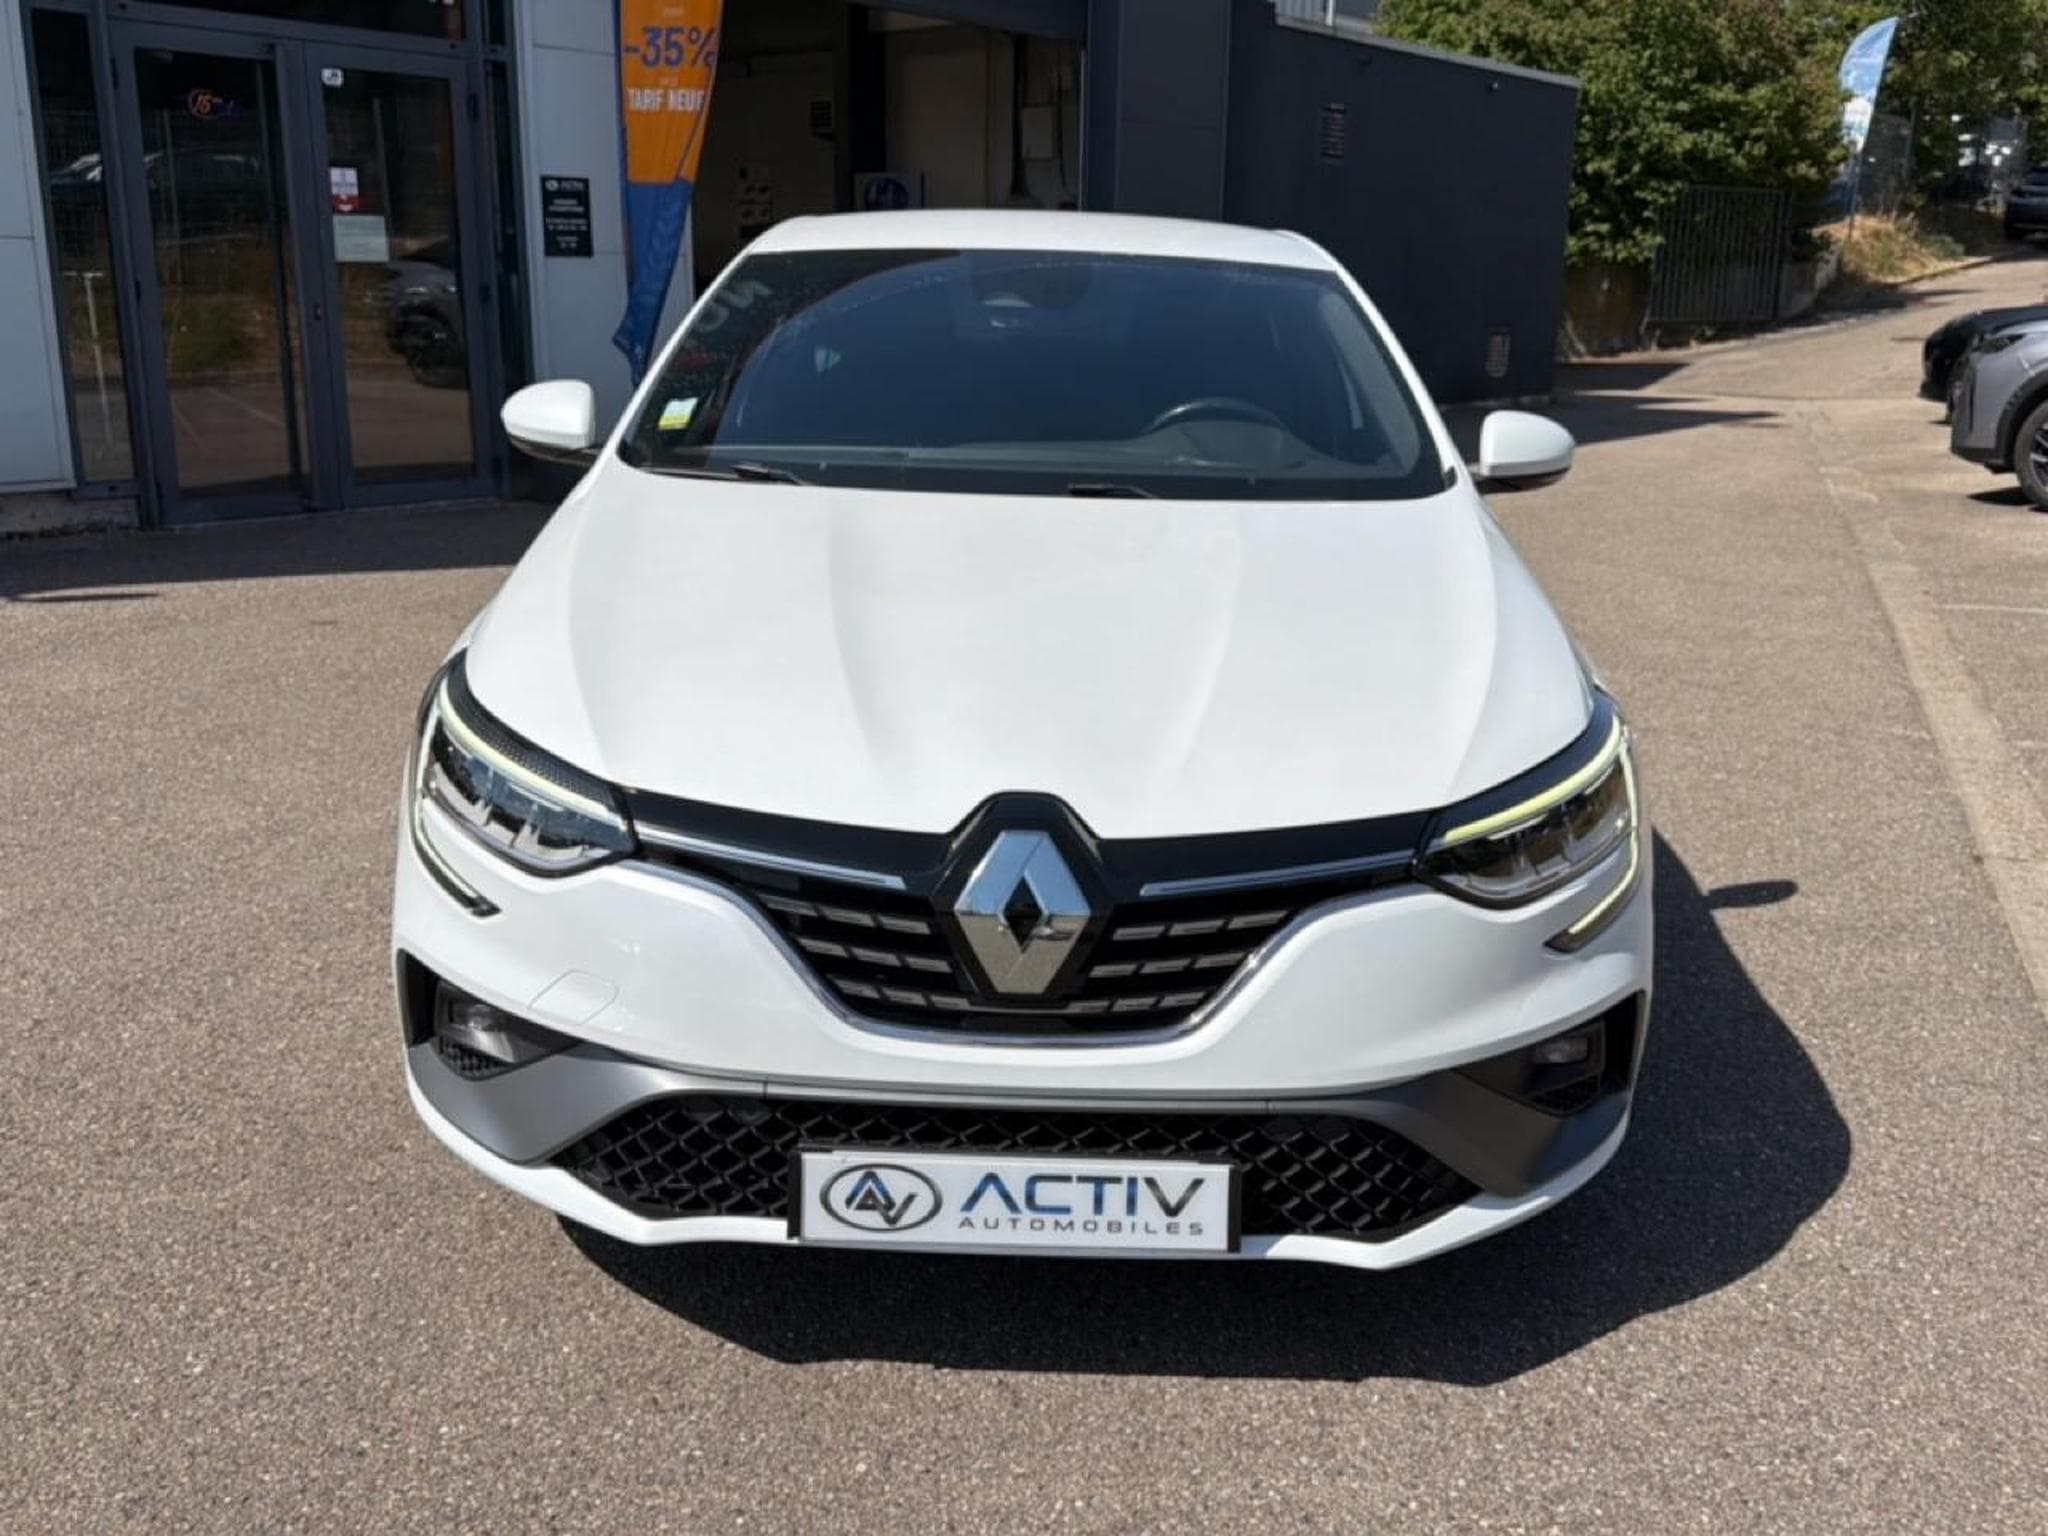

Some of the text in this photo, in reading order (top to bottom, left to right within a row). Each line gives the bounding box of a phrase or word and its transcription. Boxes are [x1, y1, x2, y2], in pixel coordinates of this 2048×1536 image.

[623, 25, 719, 68] -35%
[626, 88, 705, 112] TARIF NEUF
[959, 1171, 1206, 1218] ACTIV
[957, 1215, 1204, 1236] AUTOMOBILES
